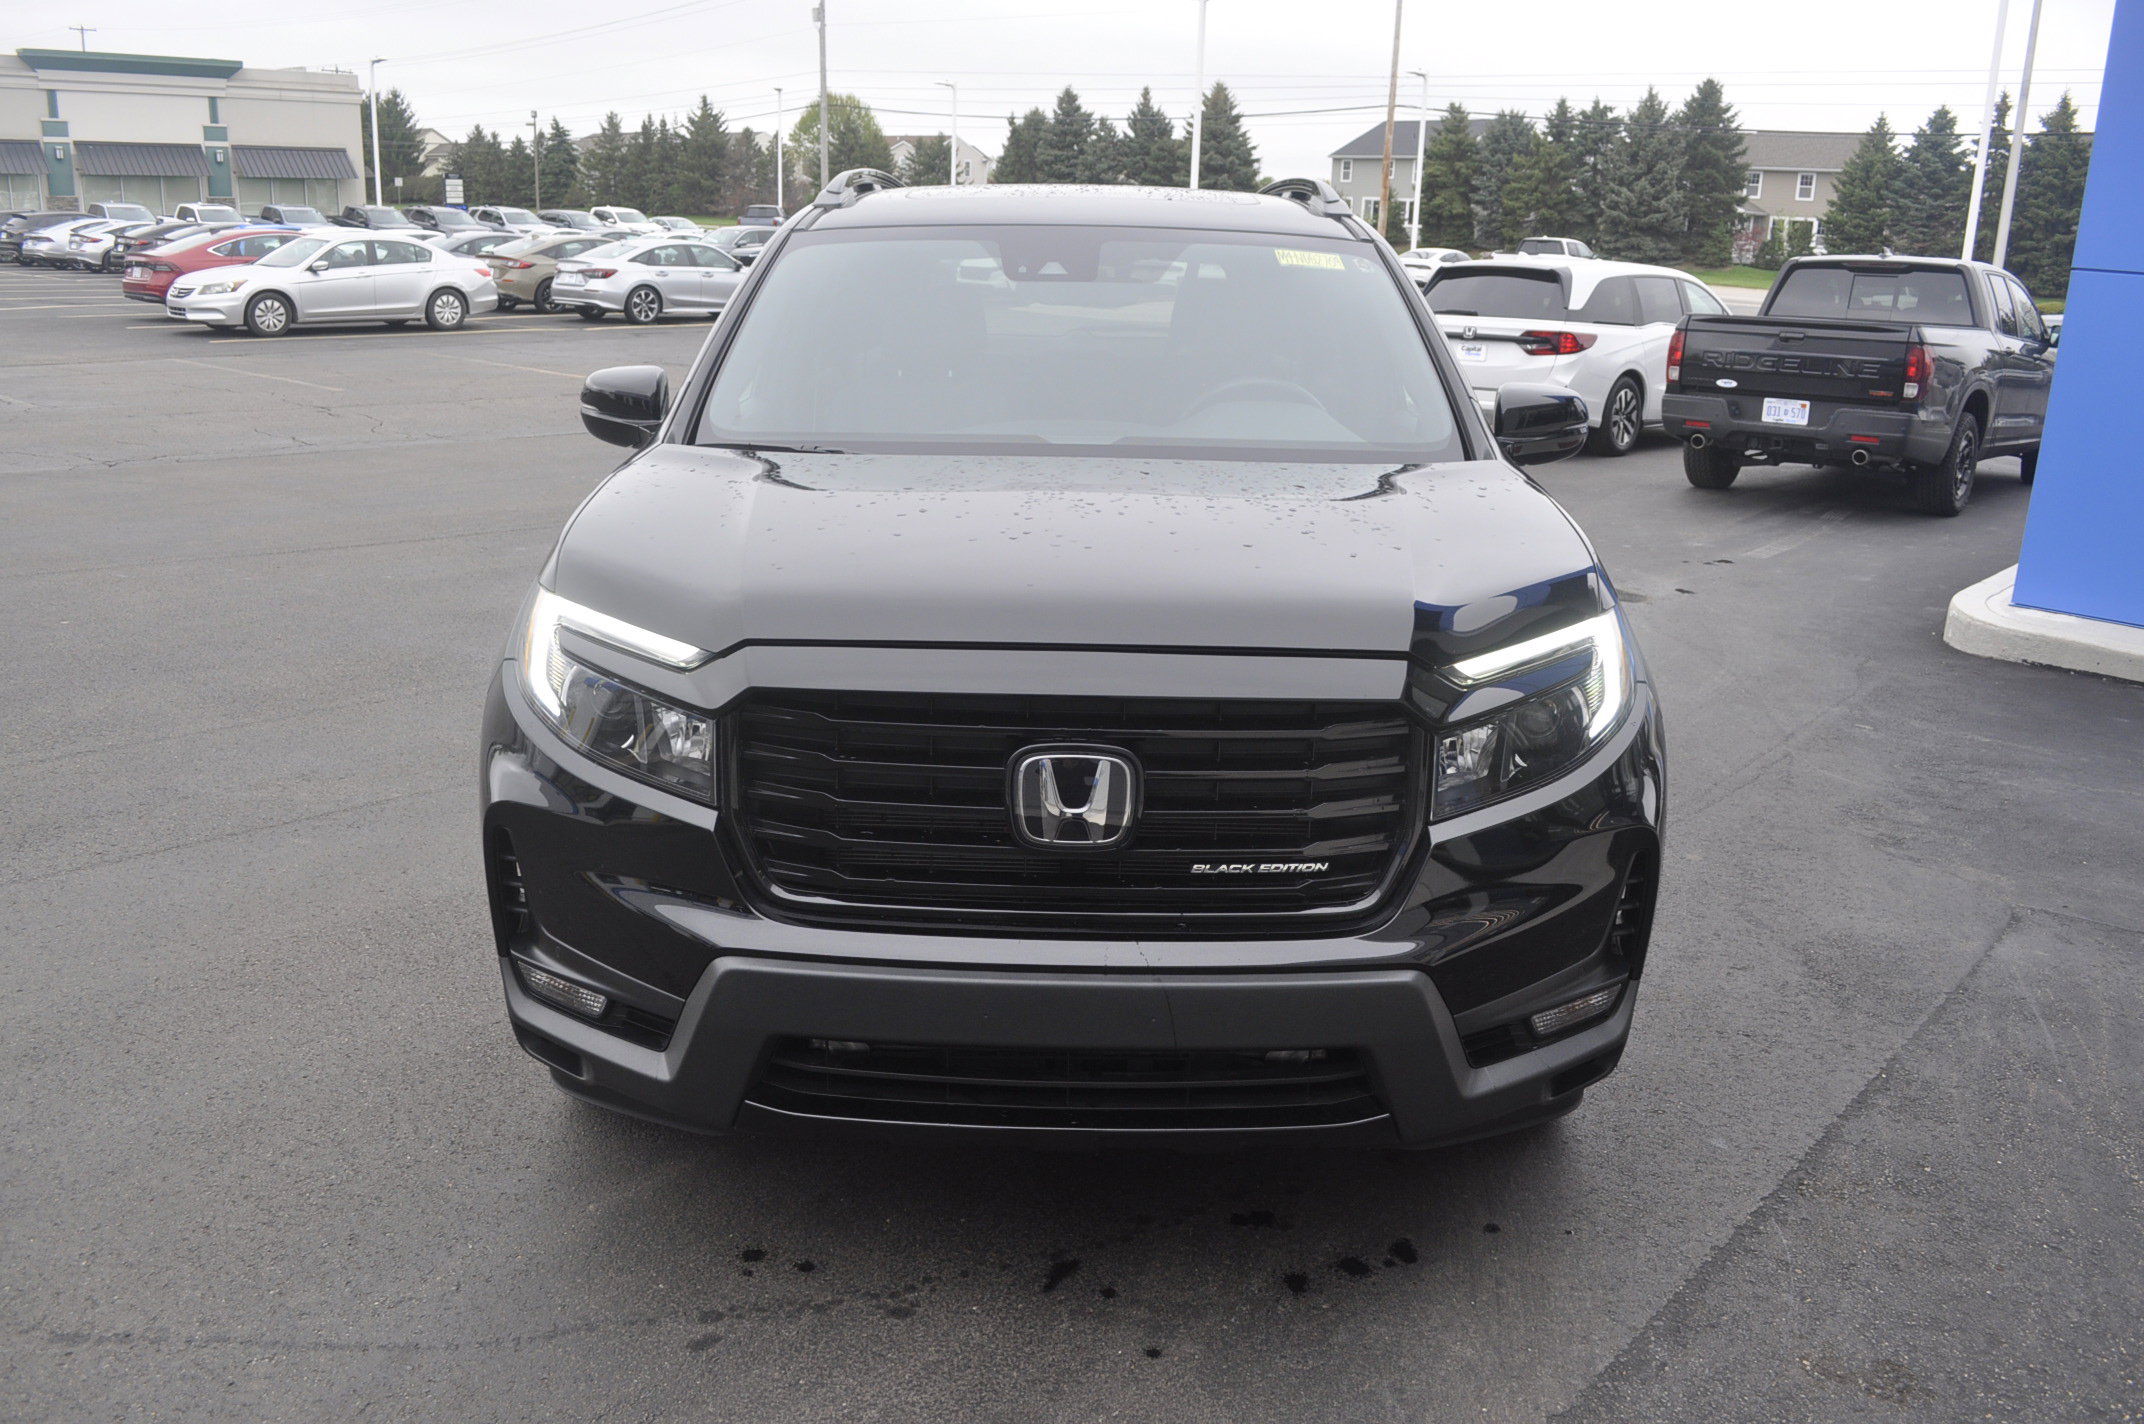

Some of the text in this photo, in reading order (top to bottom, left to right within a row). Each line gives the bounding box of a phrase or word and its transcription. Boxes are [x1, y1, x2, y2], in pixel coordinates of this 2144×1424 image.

[1702, 350, 1881, 379] RIDGELINE
[1190, 862, 1329, 874] BLACK EDITION
